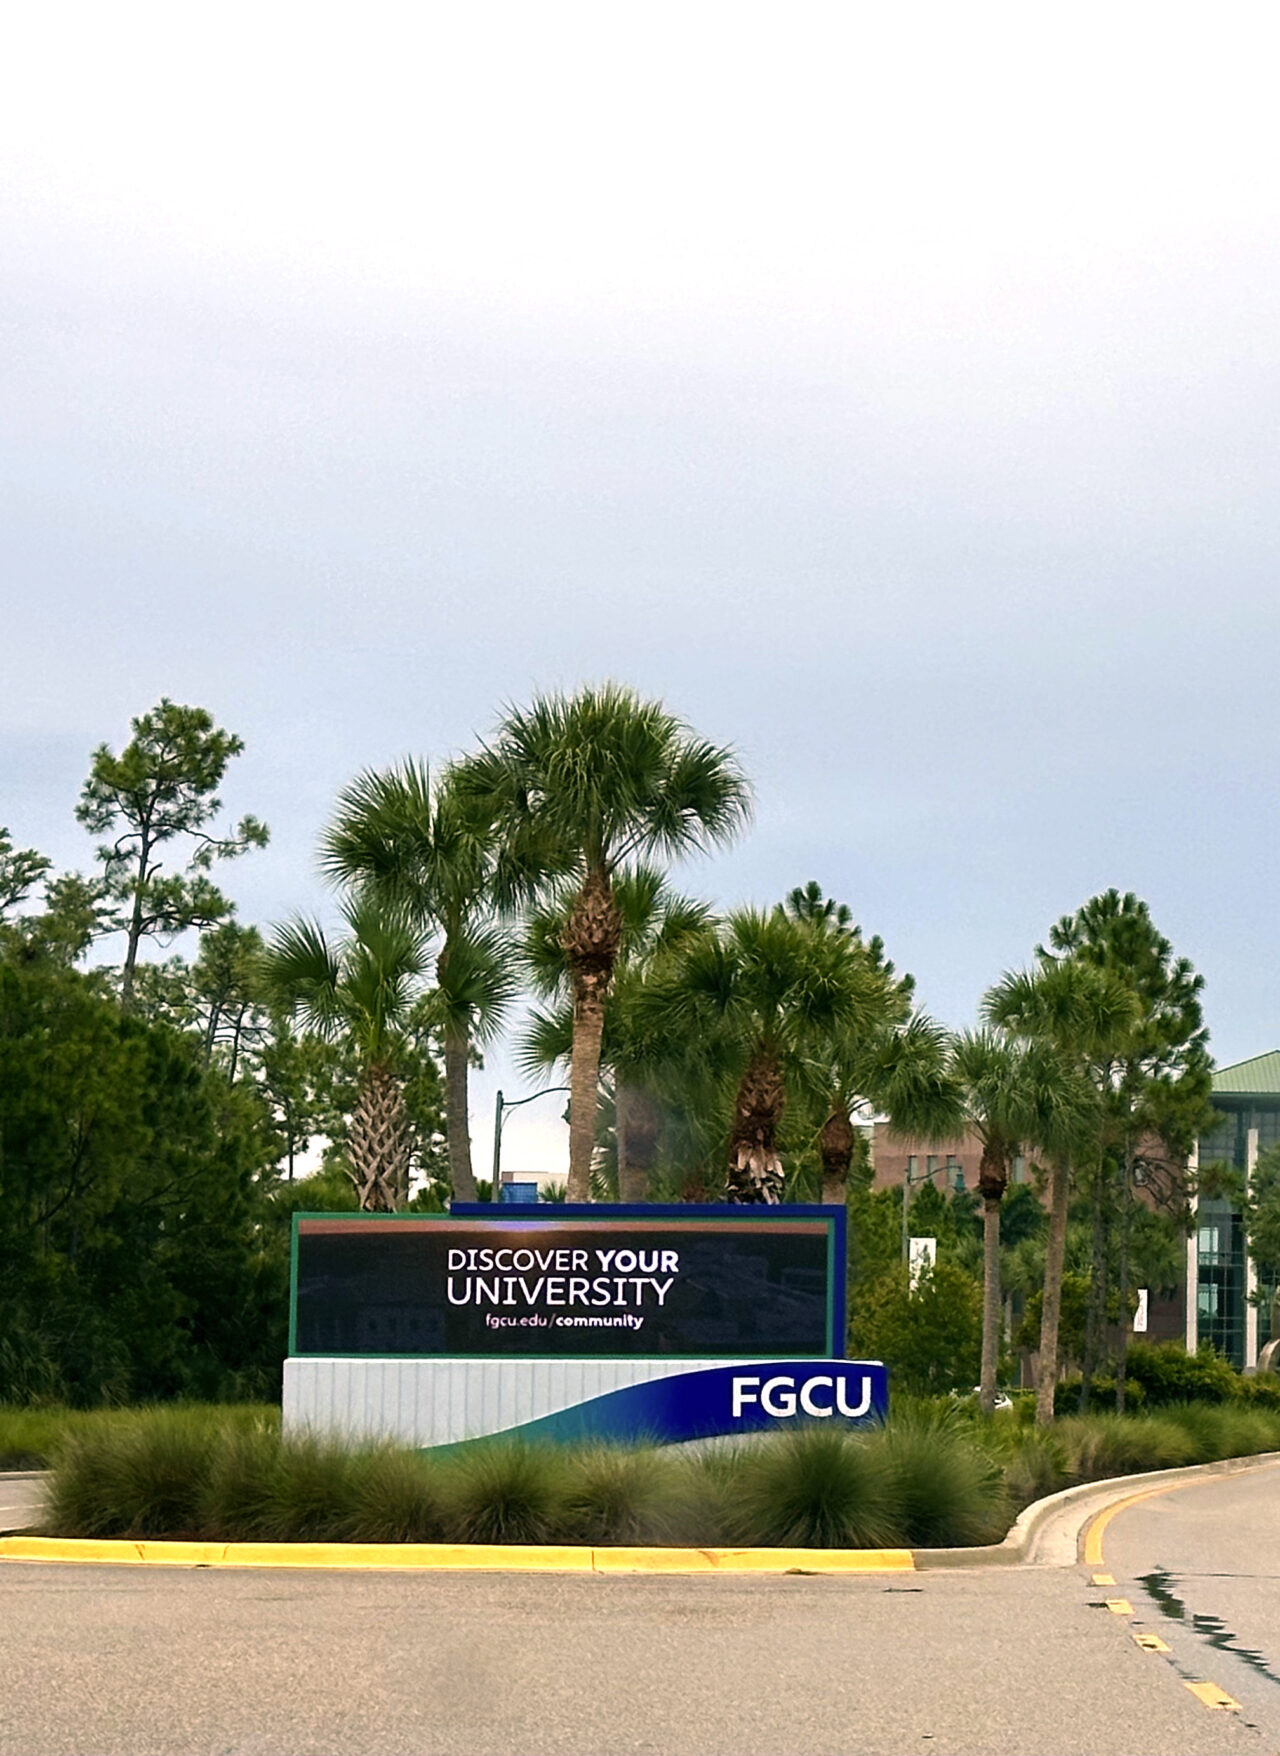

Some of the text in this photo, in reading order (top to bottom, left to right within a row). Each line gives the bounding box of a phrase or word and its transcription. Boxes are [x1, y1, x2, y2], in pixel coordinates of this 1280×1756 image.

[448, 1249, 679, 1273] DISCOVER YOUR
[447, 1276, 675, 1306] UNIVERSITY
[485, 1312, 644, 1330] fgcu.edu/community
[732, 1376, 872, 1418] FGCU
